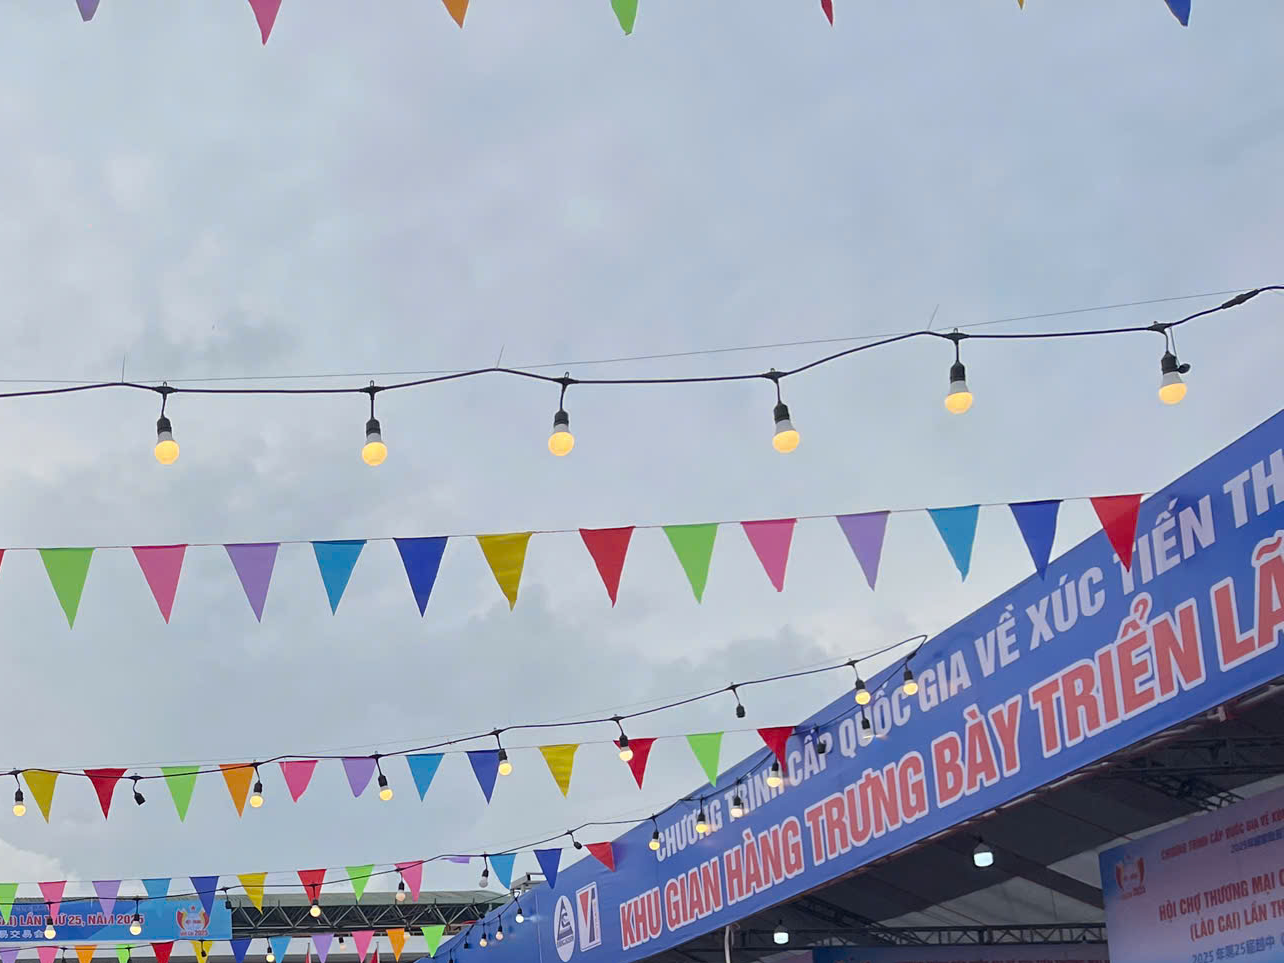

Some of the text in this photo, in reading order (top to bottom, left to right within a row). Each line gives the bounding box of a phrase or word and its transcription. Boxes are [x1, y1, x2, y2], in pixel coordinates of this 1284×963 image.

[918, 650, 973, 713] GIA
[974, 603, 1020, 678] VỀ
[1025, 566, 1106, 652] XÚC
[1112, 494, 1216, 597] TIẾN
[618, 885, 664, 951] KHU
[664, 856, 722, 933] GIAN
[722, 815, 806, 905] HÀNG
[803, 751, 929, 867] TRƯNG
[930, 694, 1022, 809] BÀY
[1028, 591, 1207, 759] TRIỂN
[116, 914, 144, 927] 205
[1158, 873, 1276, 923] HỘI CHỢ THƯƠNG MẠI
